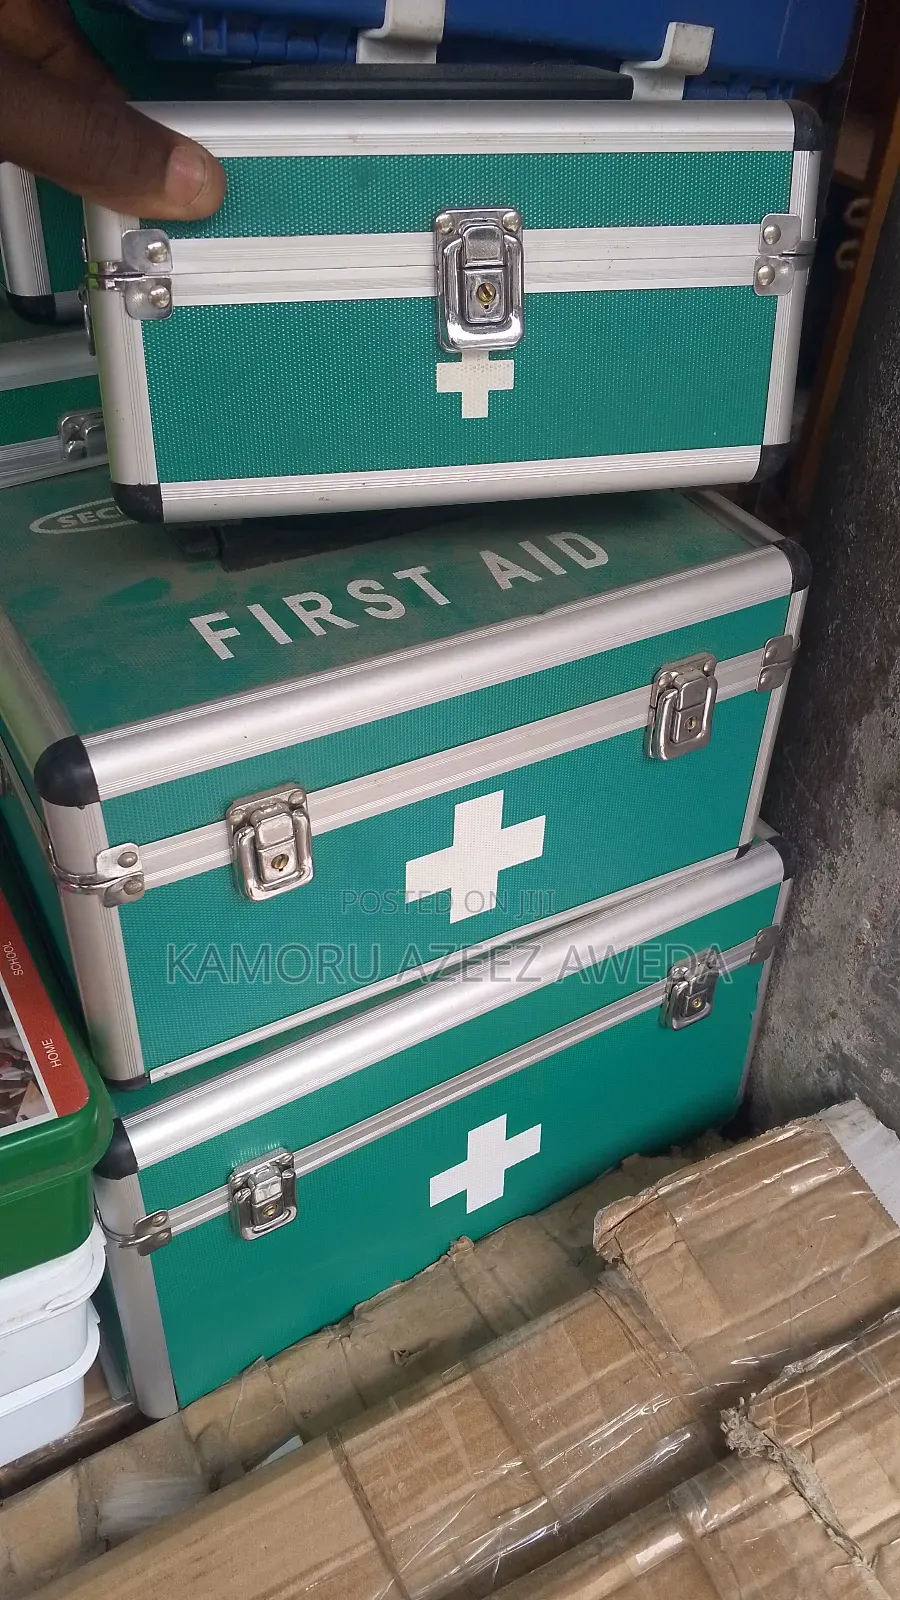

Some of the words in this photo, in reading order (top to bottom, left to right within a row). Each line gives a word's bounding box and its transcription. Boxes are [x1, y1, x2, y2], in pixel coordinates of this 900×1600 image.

[56, 506, 124, 528] SEC
[188, 566, 452, 660] FIRST
[479, 531, 610, 590] AID
[2, 940, 24, 976] SCHOOL
[41, 1038, 62, 1068] HOME
